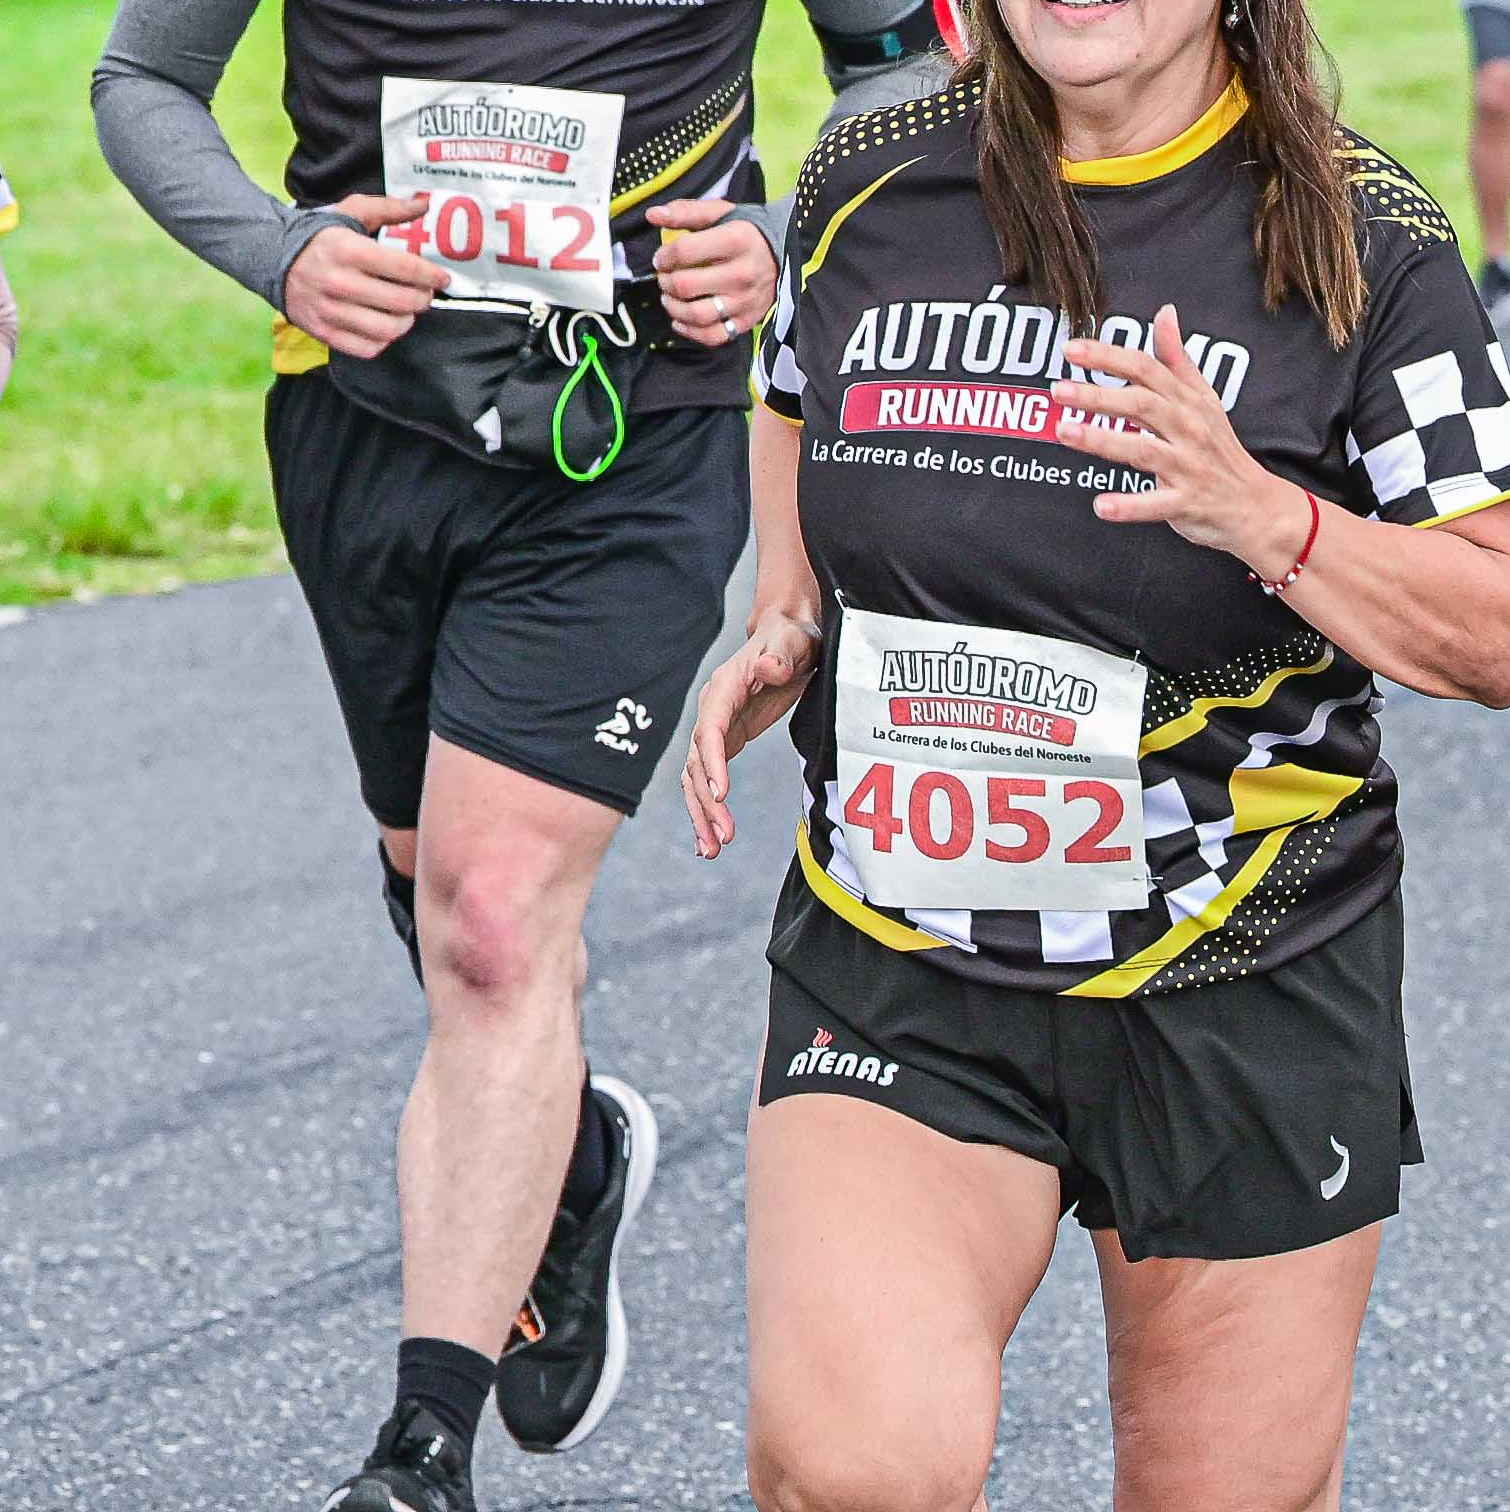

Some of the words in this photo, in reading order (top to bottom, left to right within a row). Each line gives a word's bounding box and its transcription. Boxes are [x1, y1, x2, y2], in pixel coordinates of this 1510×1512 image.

[418, 96, 586, 151] AUTÓDROMO
[440, 141, 507, 162] RUNNING
[510, 145, 555, 169] RACE
[876, 388, 1050, 434] RUNNING
[811, 438, 829, 462] La
[831, 441, 907, 467] Carrera
[913, 446, 944, 471] de
[949, 450, 985, 476] los
[990, 455, 1072, 486] Clubes
[1076, 465, 1116, 492] del
[879, 642, 1098, 716] AUTÓDROMO
[909, 700, 997, 728] RUNNING
[1001, 707, 1055, 740] RACE
[872, 726, 886, 740] La
[887, 729, 930, 748] Carrera
[932, 736, 948, 750] de
[950, 737, 968, 752] los
[970, 739, 1012, 757] Clubes
[1014, 745, 1034, 759] del
[1036, 747, 1093, 765] Noroeste
[843, 762, 1132, 864] 4052
[786, 1046, 900, 1087] ATENAS
